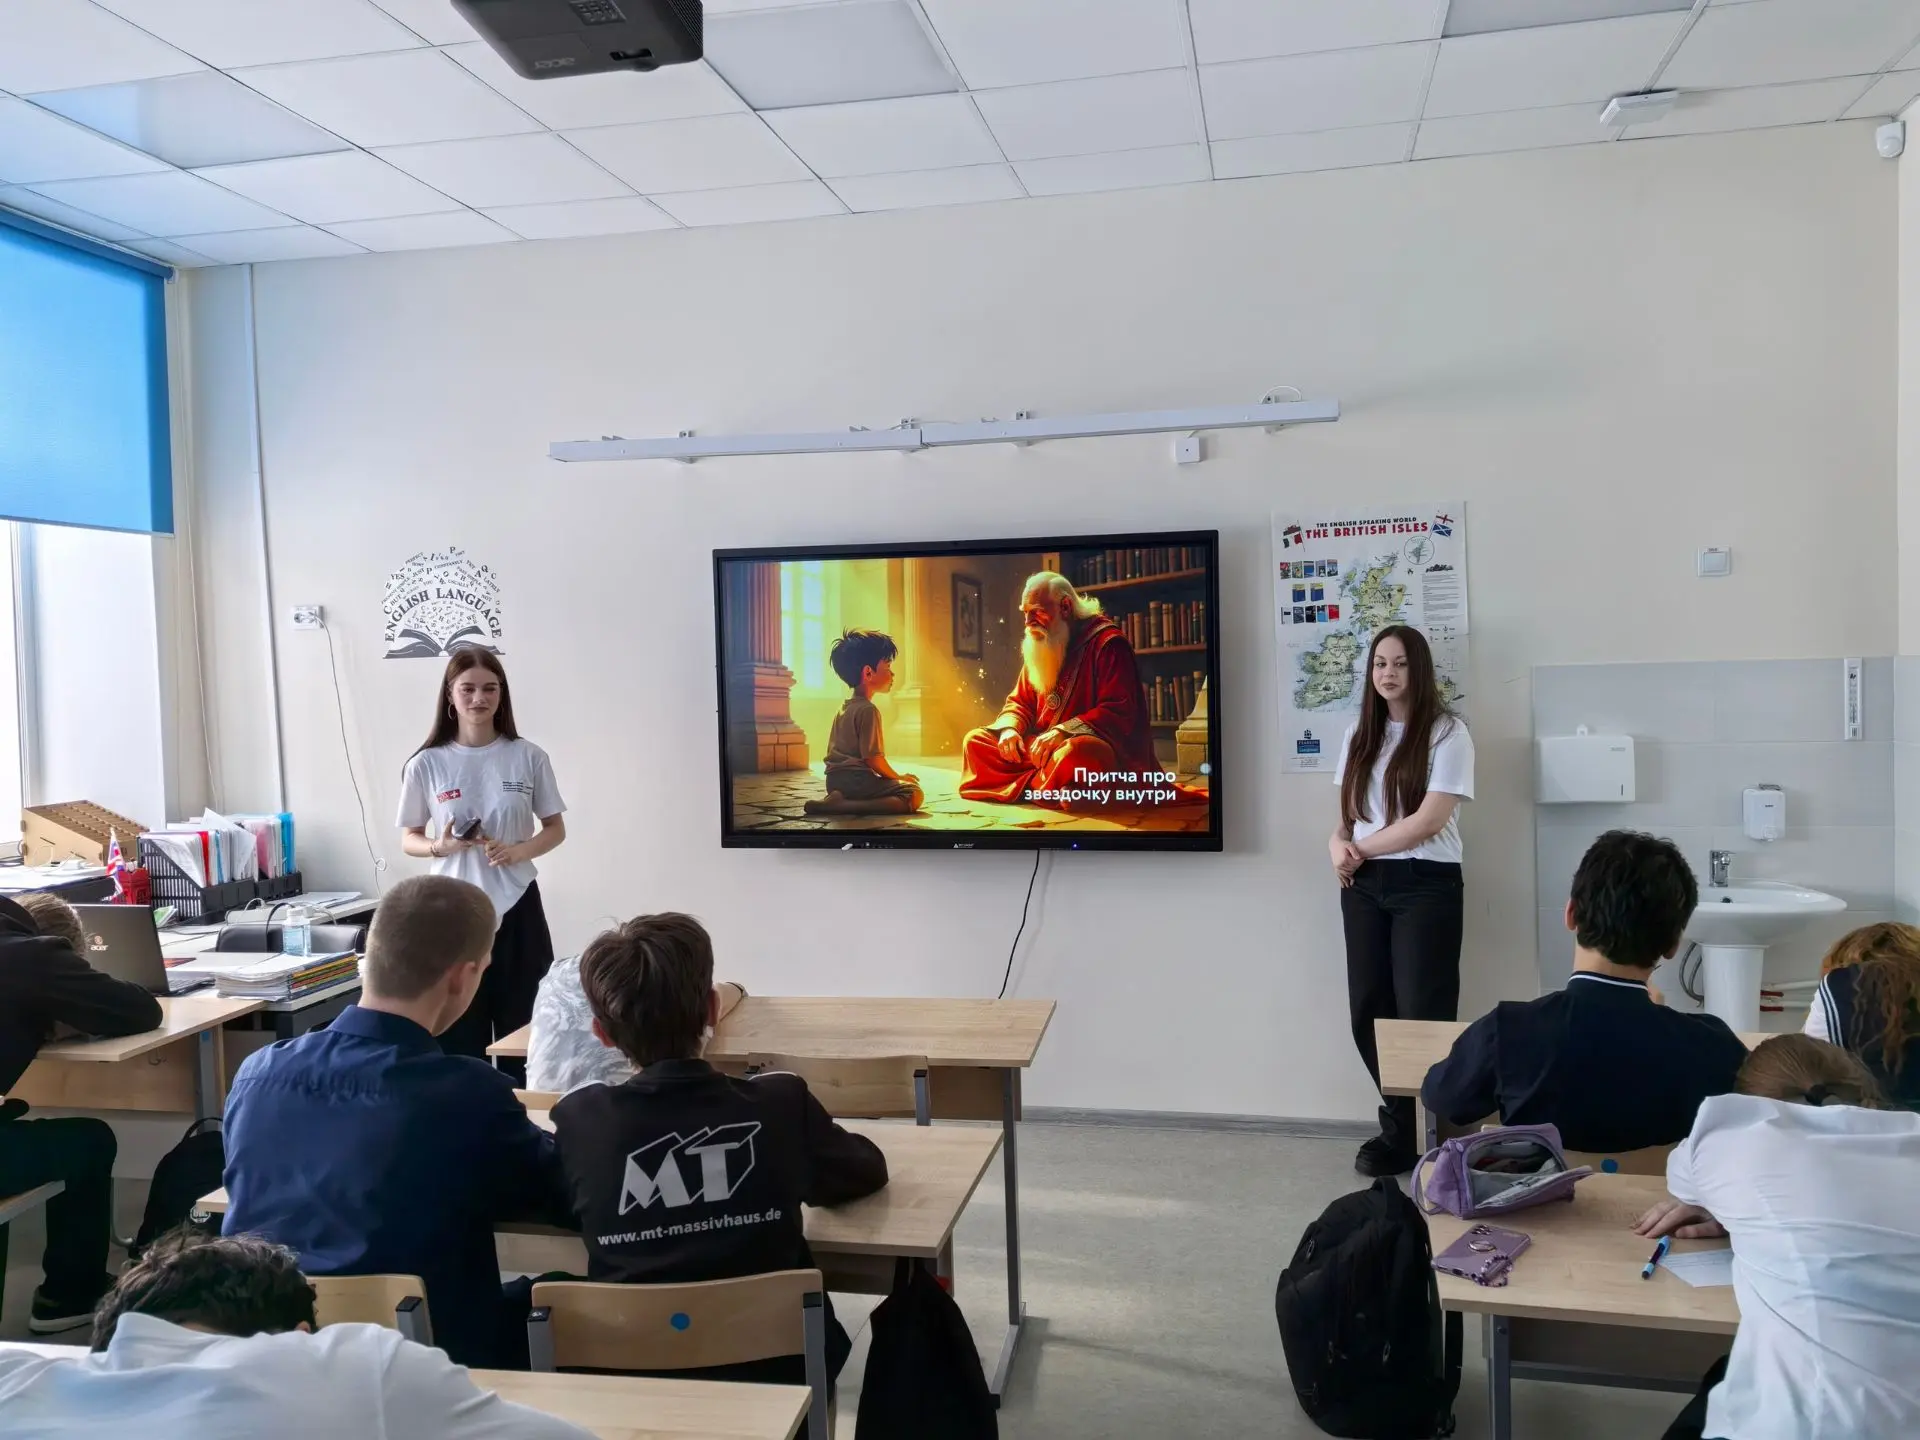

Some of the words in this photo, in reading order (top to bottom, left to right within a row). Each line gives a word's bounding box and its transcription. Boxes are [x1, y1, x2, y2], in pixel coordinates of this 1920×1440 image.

[1305, 529, 1329, 539] THE
[1334, 524, 1387, 537] BRITISH
[1392, 522, 1428, 534] ISLES
[1358, 518, 1391, 526] SPEAKING
[385, 590, 430, 642] ENGLISH
[436, 587, 502, 638] LANGUAGE
[1074, 767, 1137, 787] Притча
[1142, 771, 1176, 787] про
[1024, 788, 1110, 804] звездочку
[1115, 789, 1176, 804] внутри
[618, 1121, 762, 1216] MT
[597, 1207, 782, 1246] www.mt-massivhaus.de
